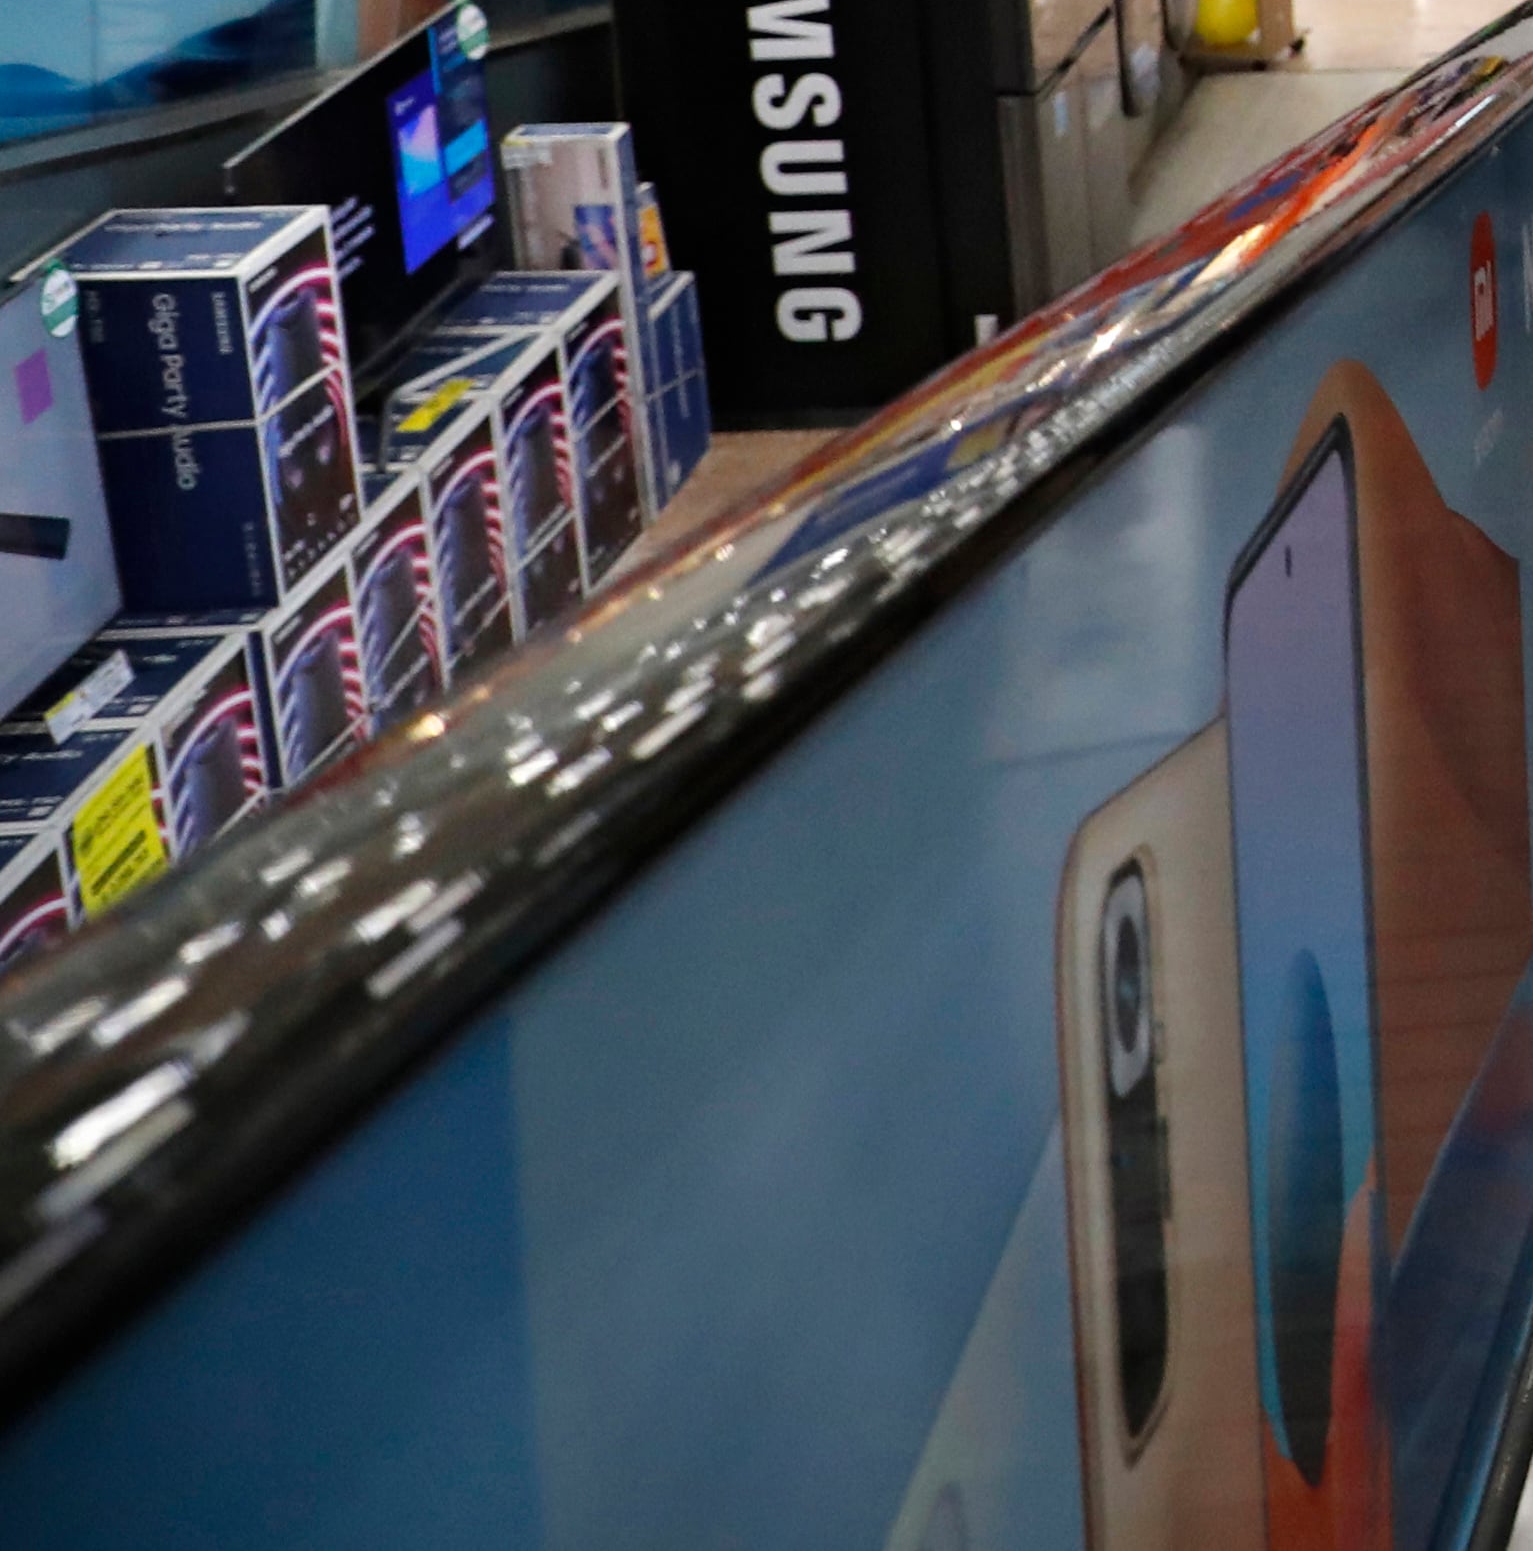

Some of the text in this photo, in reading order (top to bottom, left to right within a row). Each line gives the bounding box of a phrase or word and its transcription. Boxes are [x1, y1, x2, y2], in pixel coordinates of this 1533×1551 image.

[146, 292, 201, 492] Giga Party udio
